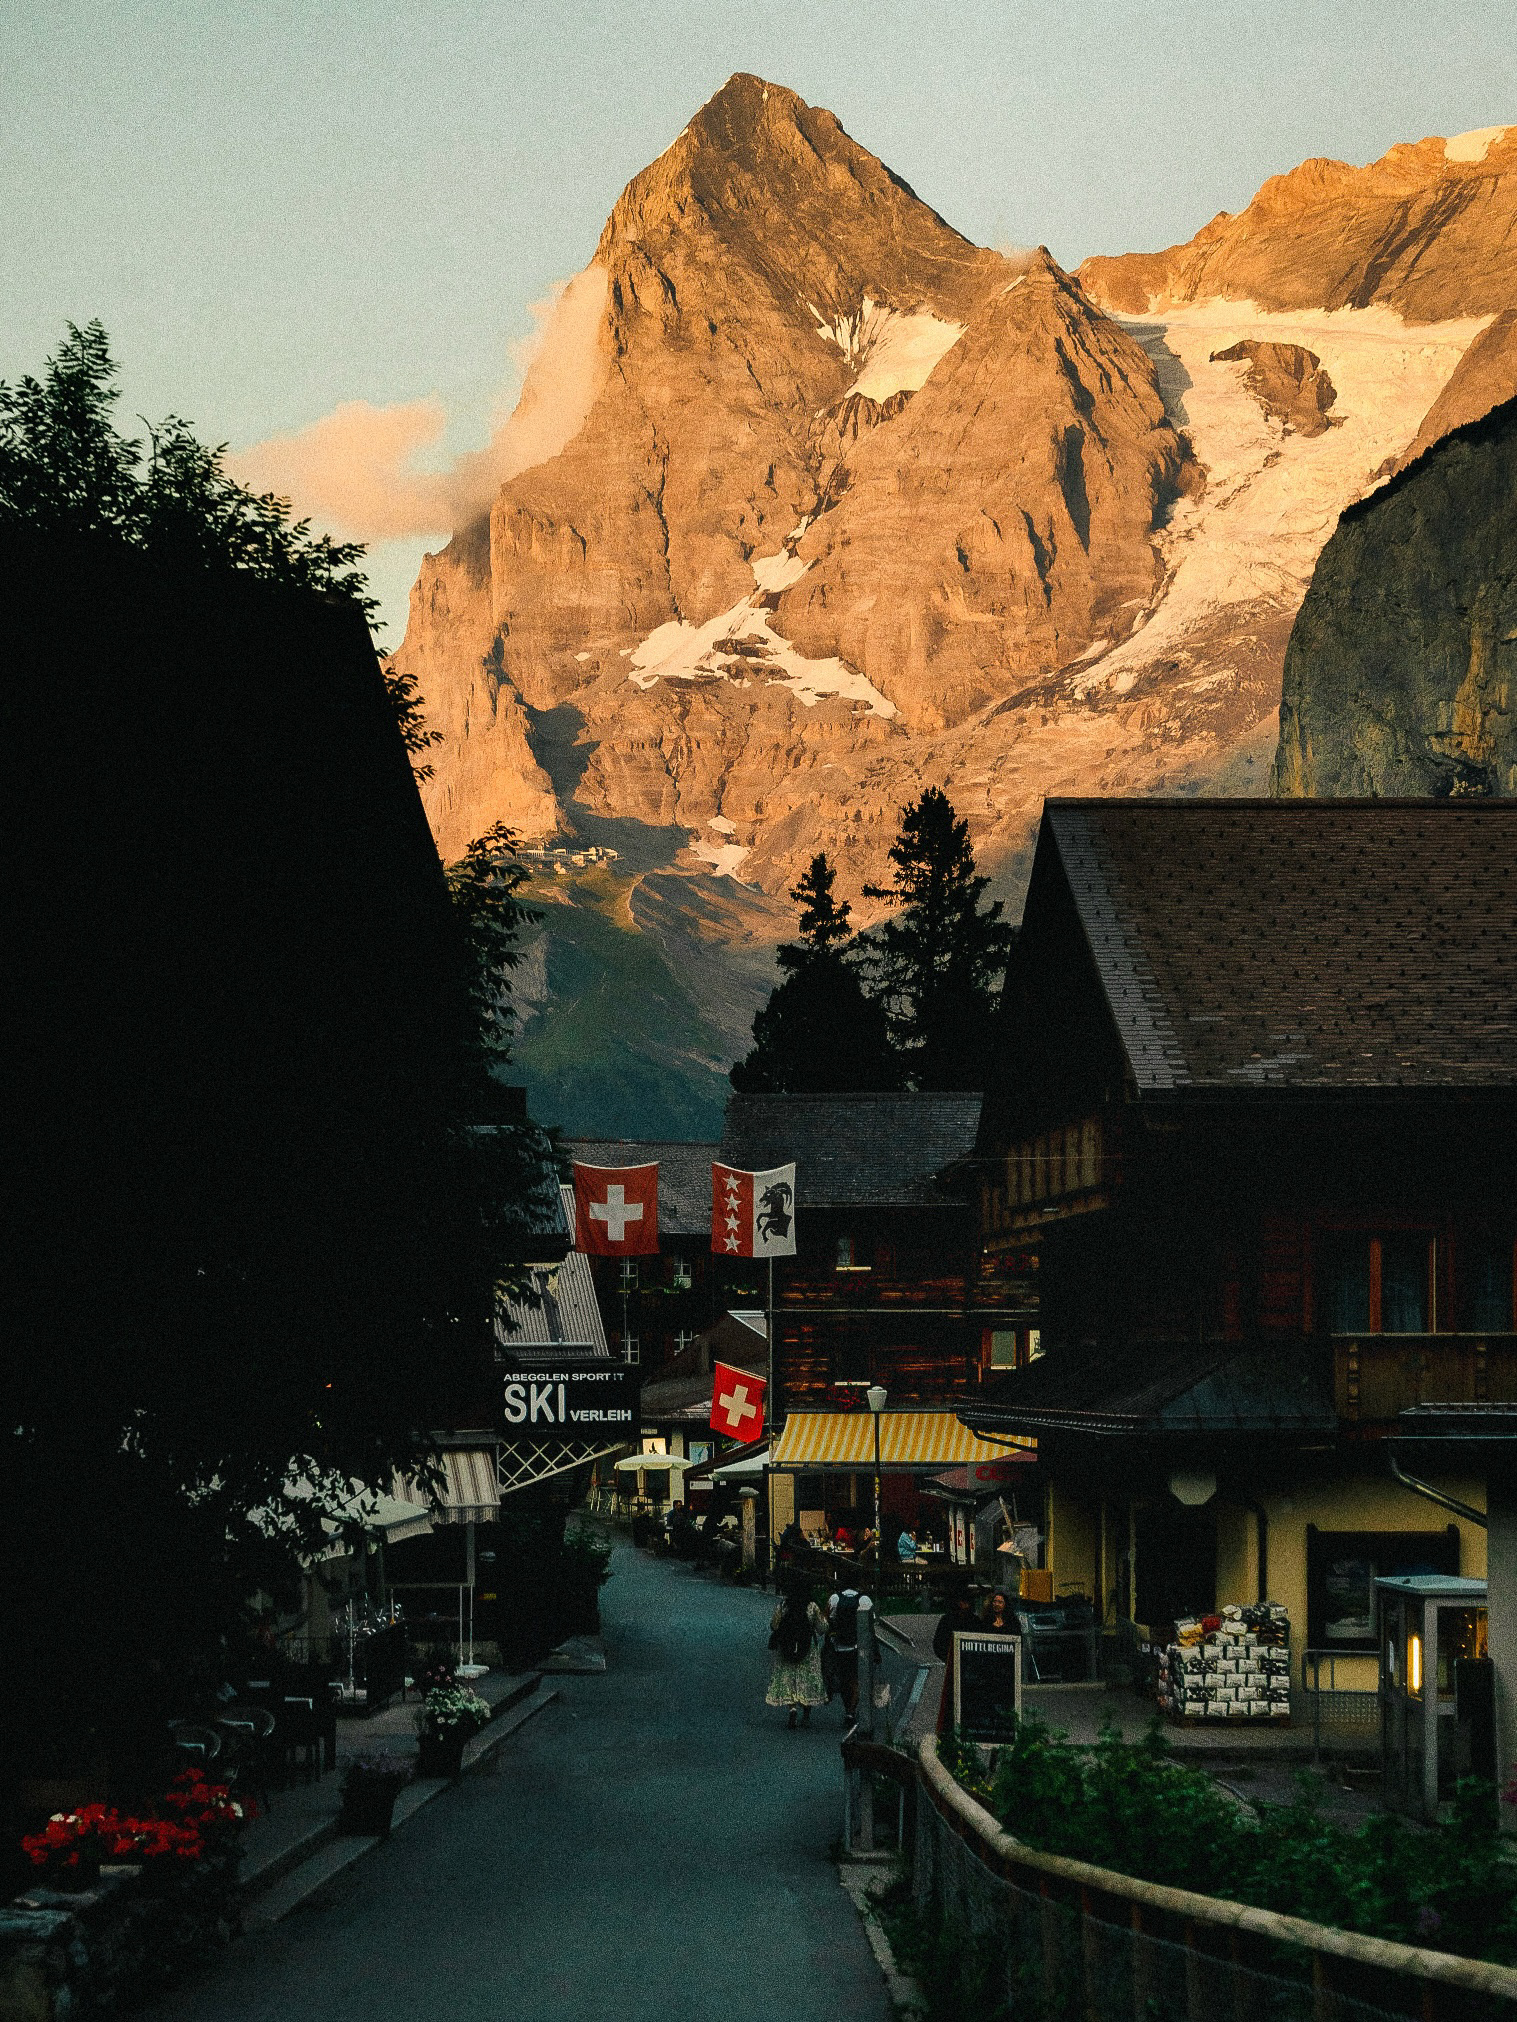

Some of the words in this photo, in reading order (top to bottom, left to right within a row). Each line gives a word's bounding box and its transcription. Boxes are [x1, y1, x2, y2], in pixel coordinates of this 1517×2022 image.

[503, 1373, 569, 1381] ABEGGLEN
[571, 1373, 611, 1381] SPORT
[504, 1383, 565, 1423] SKI
[570, 1410, 632, 1422] VERLEIH
